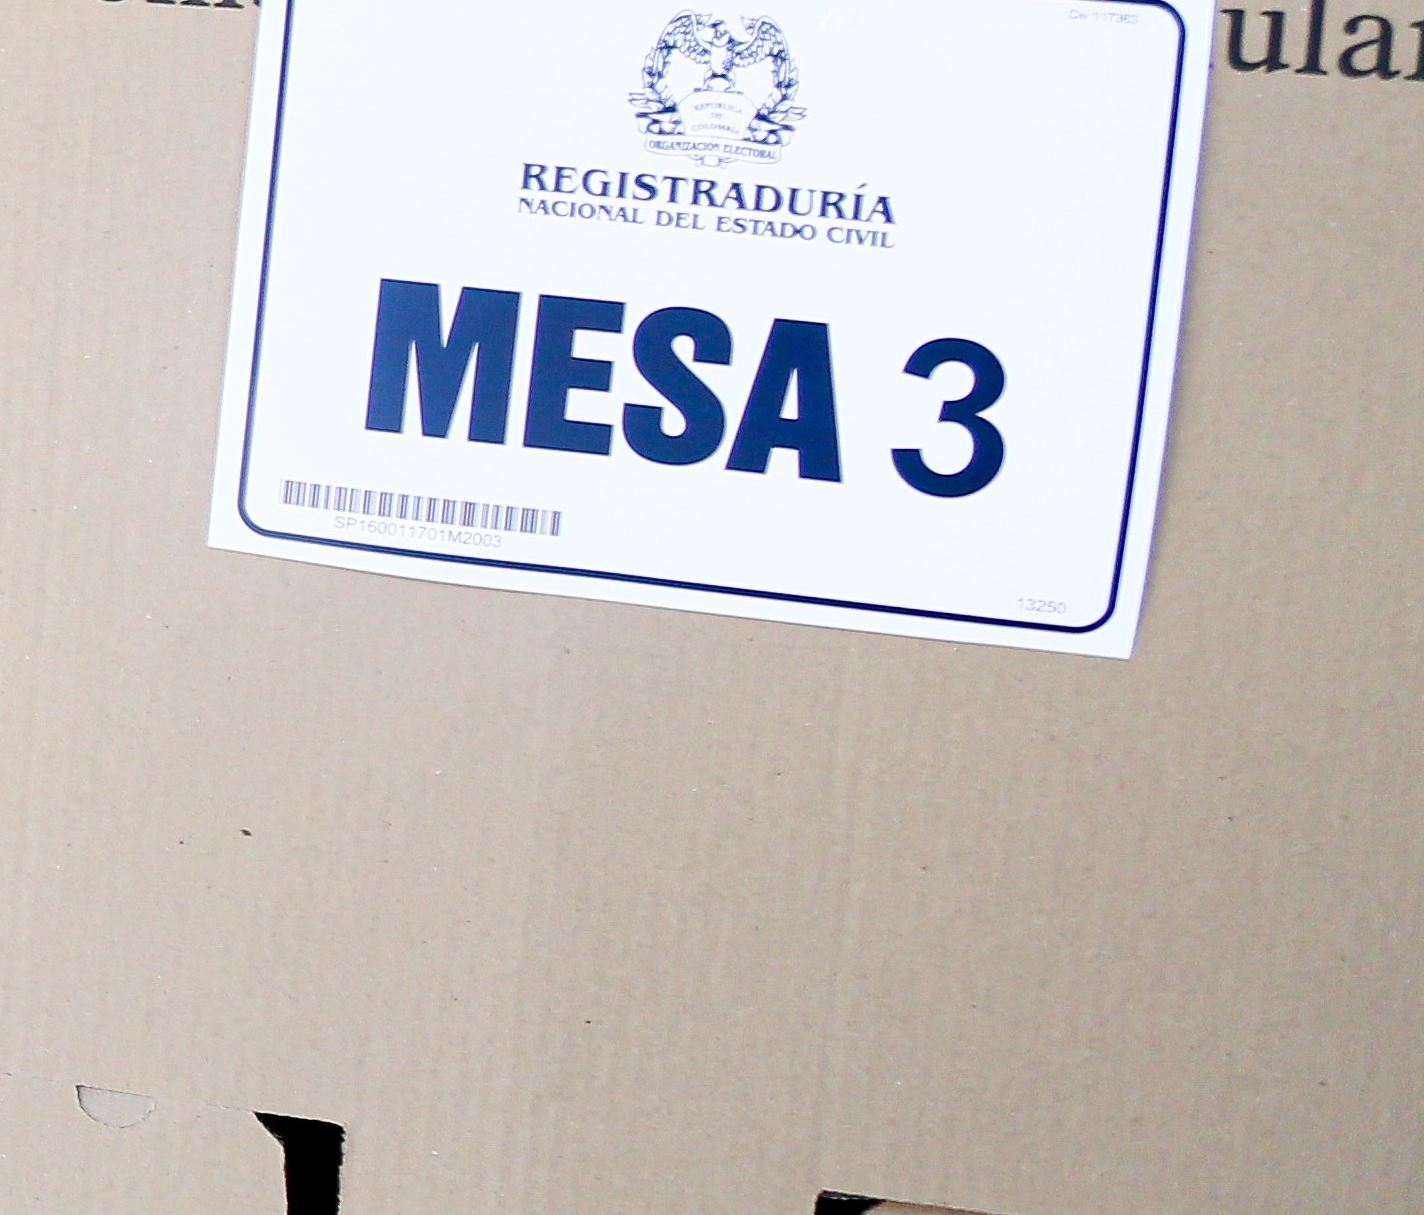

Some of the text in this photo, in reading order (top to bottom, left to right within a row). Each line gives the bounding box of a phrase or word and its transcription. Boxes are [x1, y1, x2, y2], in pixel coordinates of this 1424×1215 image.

[722, 143, 778, 160] ELECTORAL
[519, 161, 896, 225] REGISTRADURÍA
[518, 196, 896, 249] NACIONAL DEL ESTADO CIVIL
[364, 277, 1007, 499] MESA 3
[333, 514, 503, 549] SP160011701M2003
